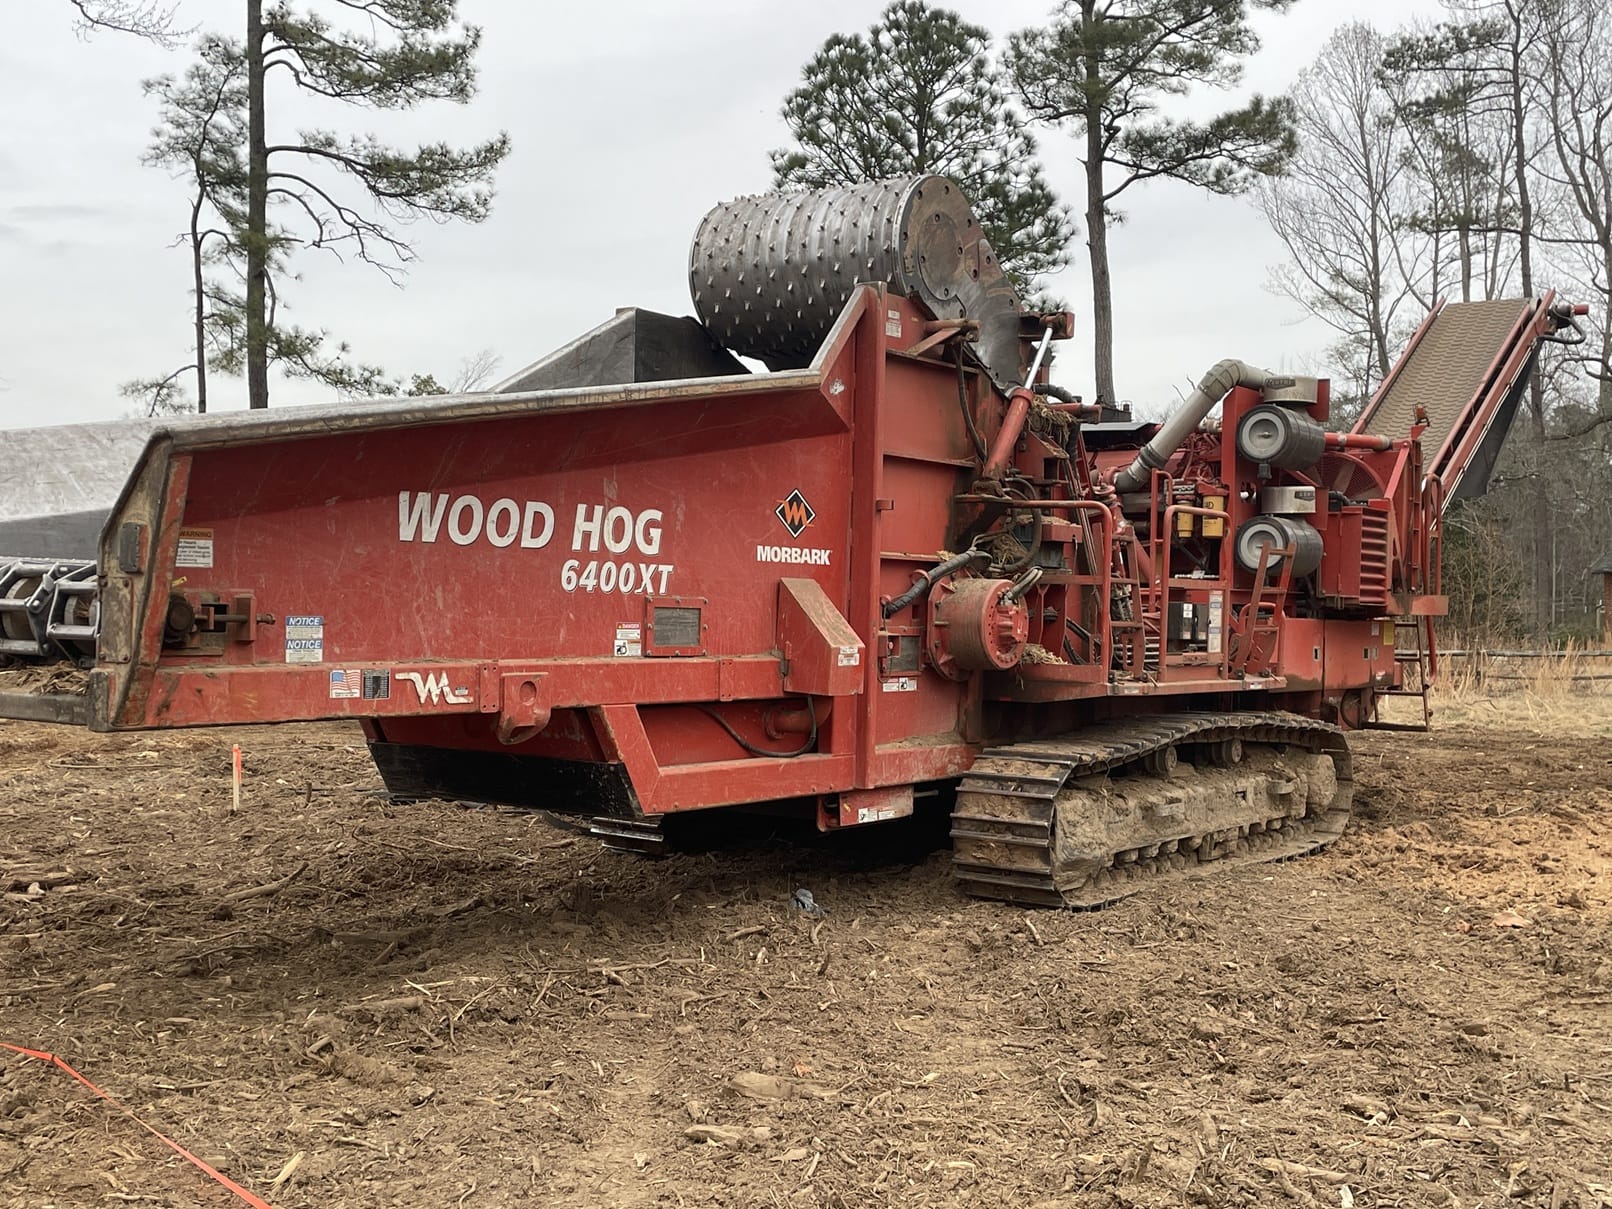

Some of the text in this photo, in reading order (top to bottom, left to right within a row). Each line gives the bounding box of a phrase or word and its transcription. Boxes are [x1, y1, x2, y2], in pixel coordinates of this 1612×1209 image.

[398, 490, 663, 555] WOOD HOG
[756, 545, 831, 565] MORBARK
[560, 559, 674, 595] 6400XT
[289, 617, 320, 625] NOTICE
[287, 640, 321, 648] NOTICE
